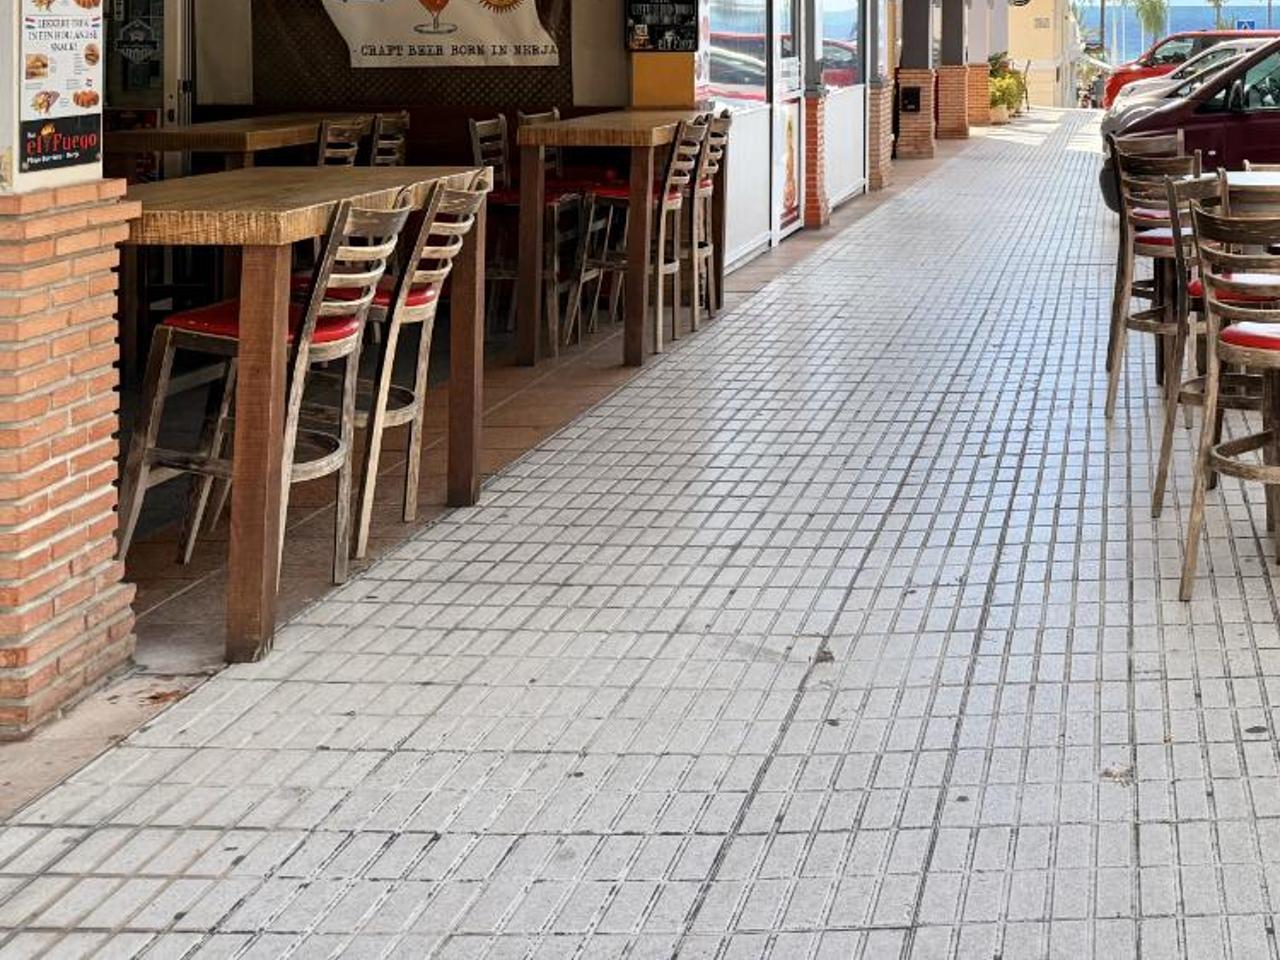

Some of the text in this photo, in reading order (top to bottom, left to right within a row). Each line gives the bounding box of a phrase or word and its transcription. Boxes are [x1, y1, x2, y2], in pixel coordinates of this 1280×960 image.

[361, 44, 558, 56] CRAFT BEER BORN IN NERJA
[53, 132, 97, 152] Fuego
